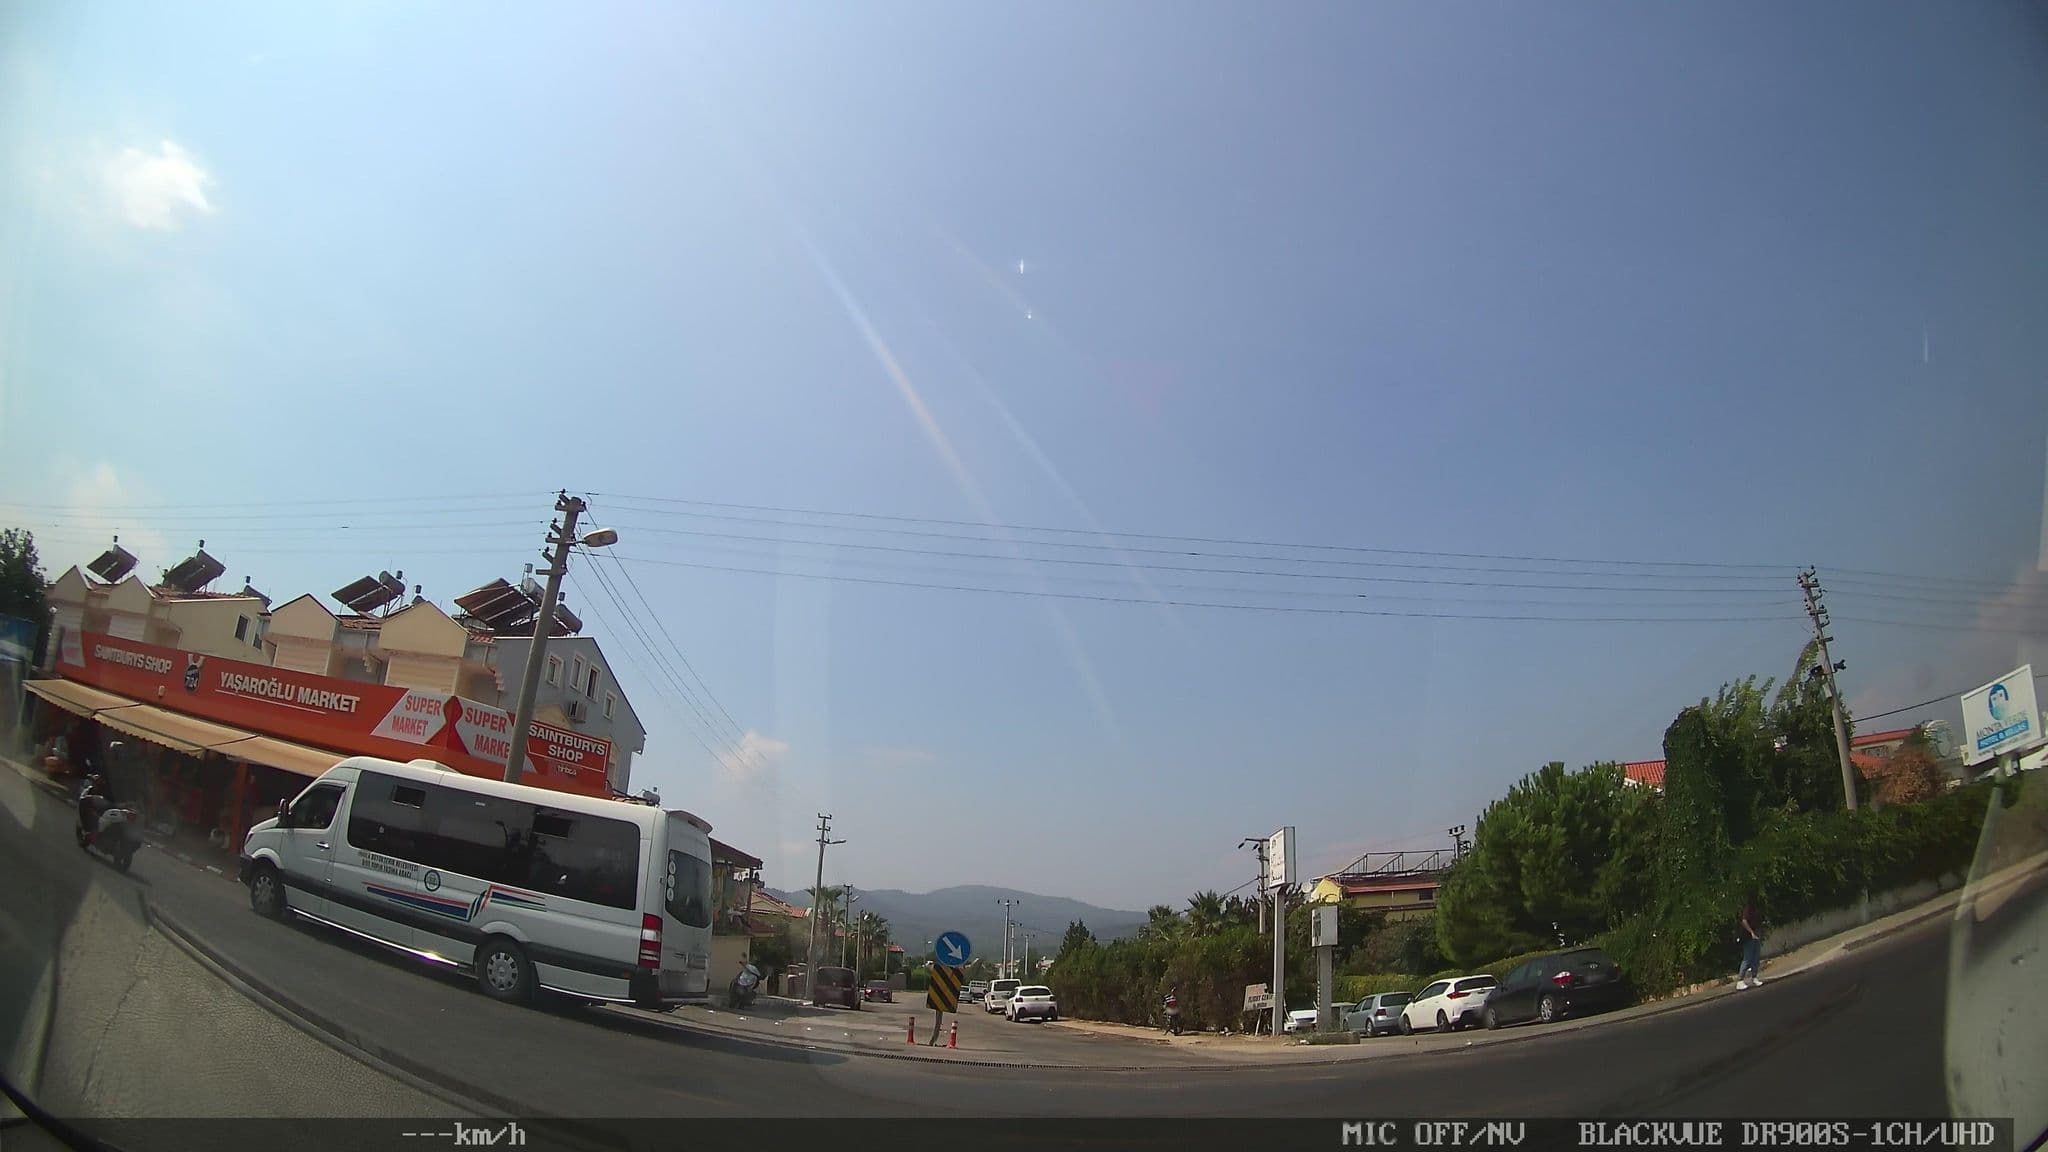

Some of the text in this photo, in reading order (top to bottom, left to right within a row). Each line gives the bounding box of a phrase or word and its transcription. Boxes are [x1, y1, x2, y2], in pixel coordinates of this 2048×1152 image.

[145, 655, 172, 675] SHOP
[220, 671, 361, 713] YAŞAROĞLU MARKET
[405, 694, 442, 717] SUPER
[392, 714, 429, 737] MARKET
[464, 706, 507, 734] SUPER
[474, 733, 511, 759] MARKE
[528, 724, 606, 756] SAINTBURYS
[548, 744, 584, 763] SHOP
